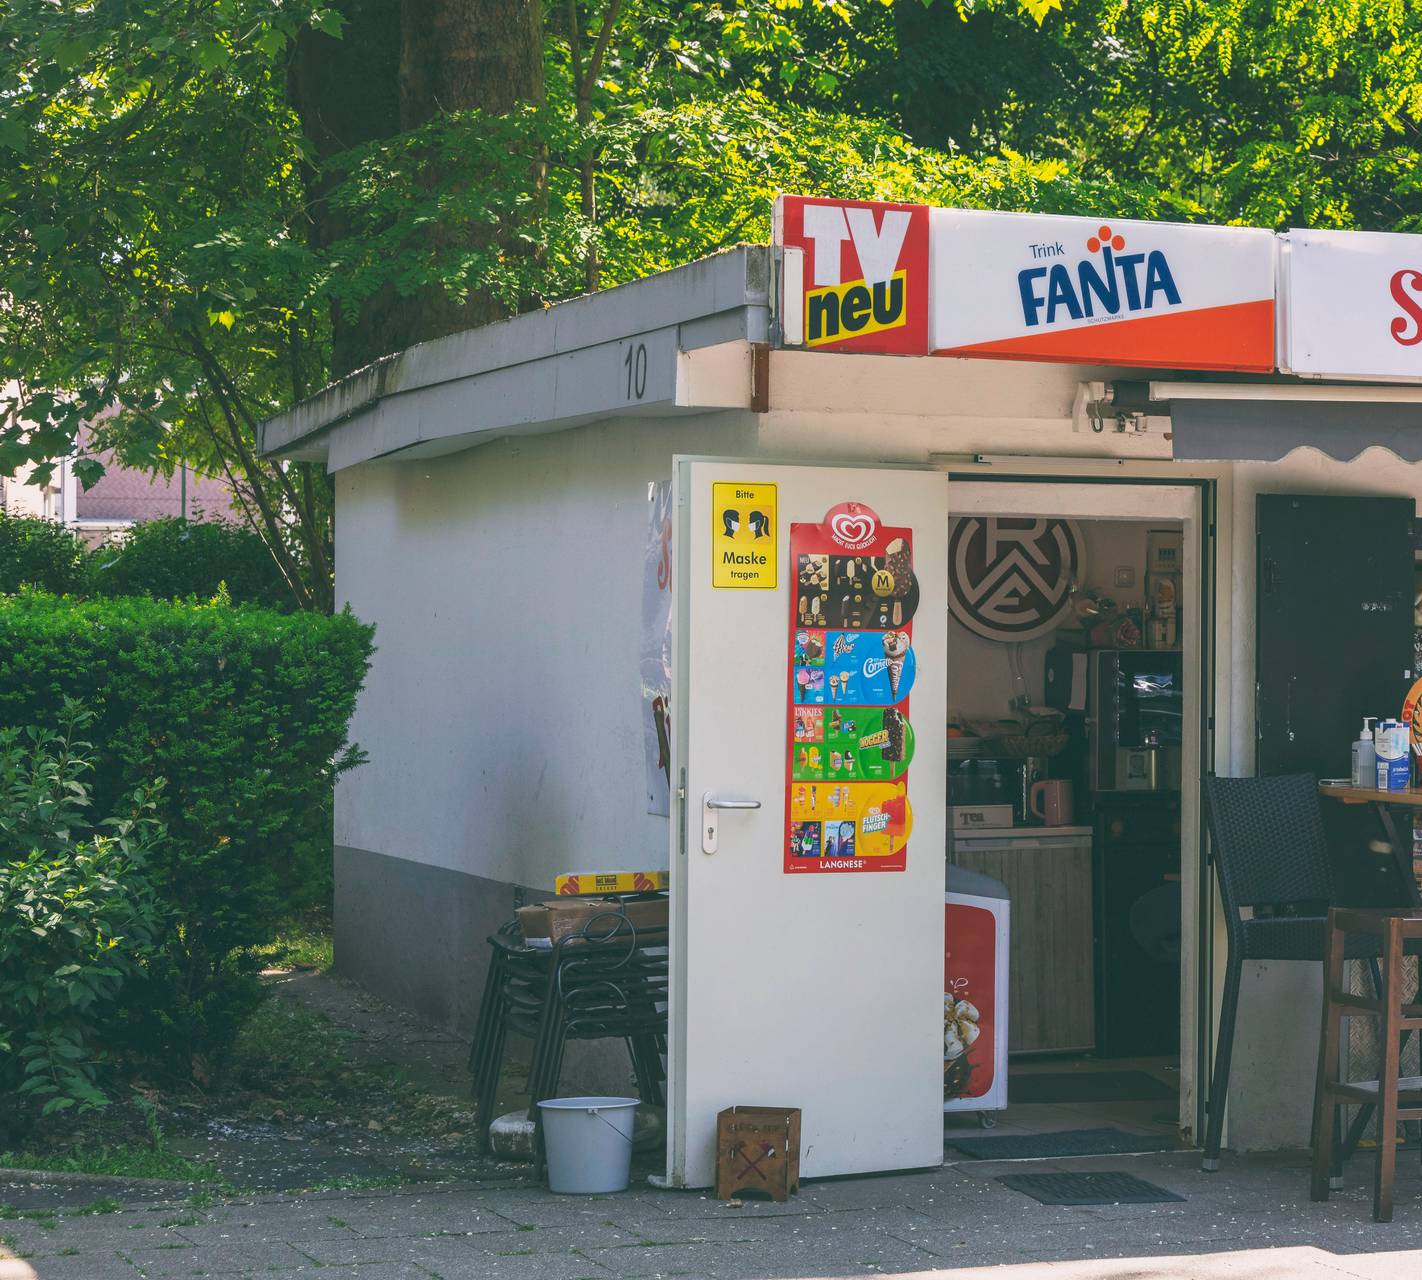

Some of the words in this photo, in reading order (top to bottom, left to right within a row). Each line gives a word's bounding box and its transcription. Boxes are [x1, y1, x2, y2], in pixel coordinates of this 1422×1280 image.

[804, 204, 912, 288] TV
[1029, 242, 1065, 259] Trink
[1018, 246, 1182, 327] FANTA
[809, 277, 903, 341] neu
[625, 344, 647, 400] 10
[736, 490, 755, 499] Bitte
[723, 552, 767, 565] Maske
[731, 571, 760, 581] tragen
[960, 812, 985, 825] Tea
[863, 821, 887, 833] FINGER
[820, 860, 864, 869] LANGNESE
